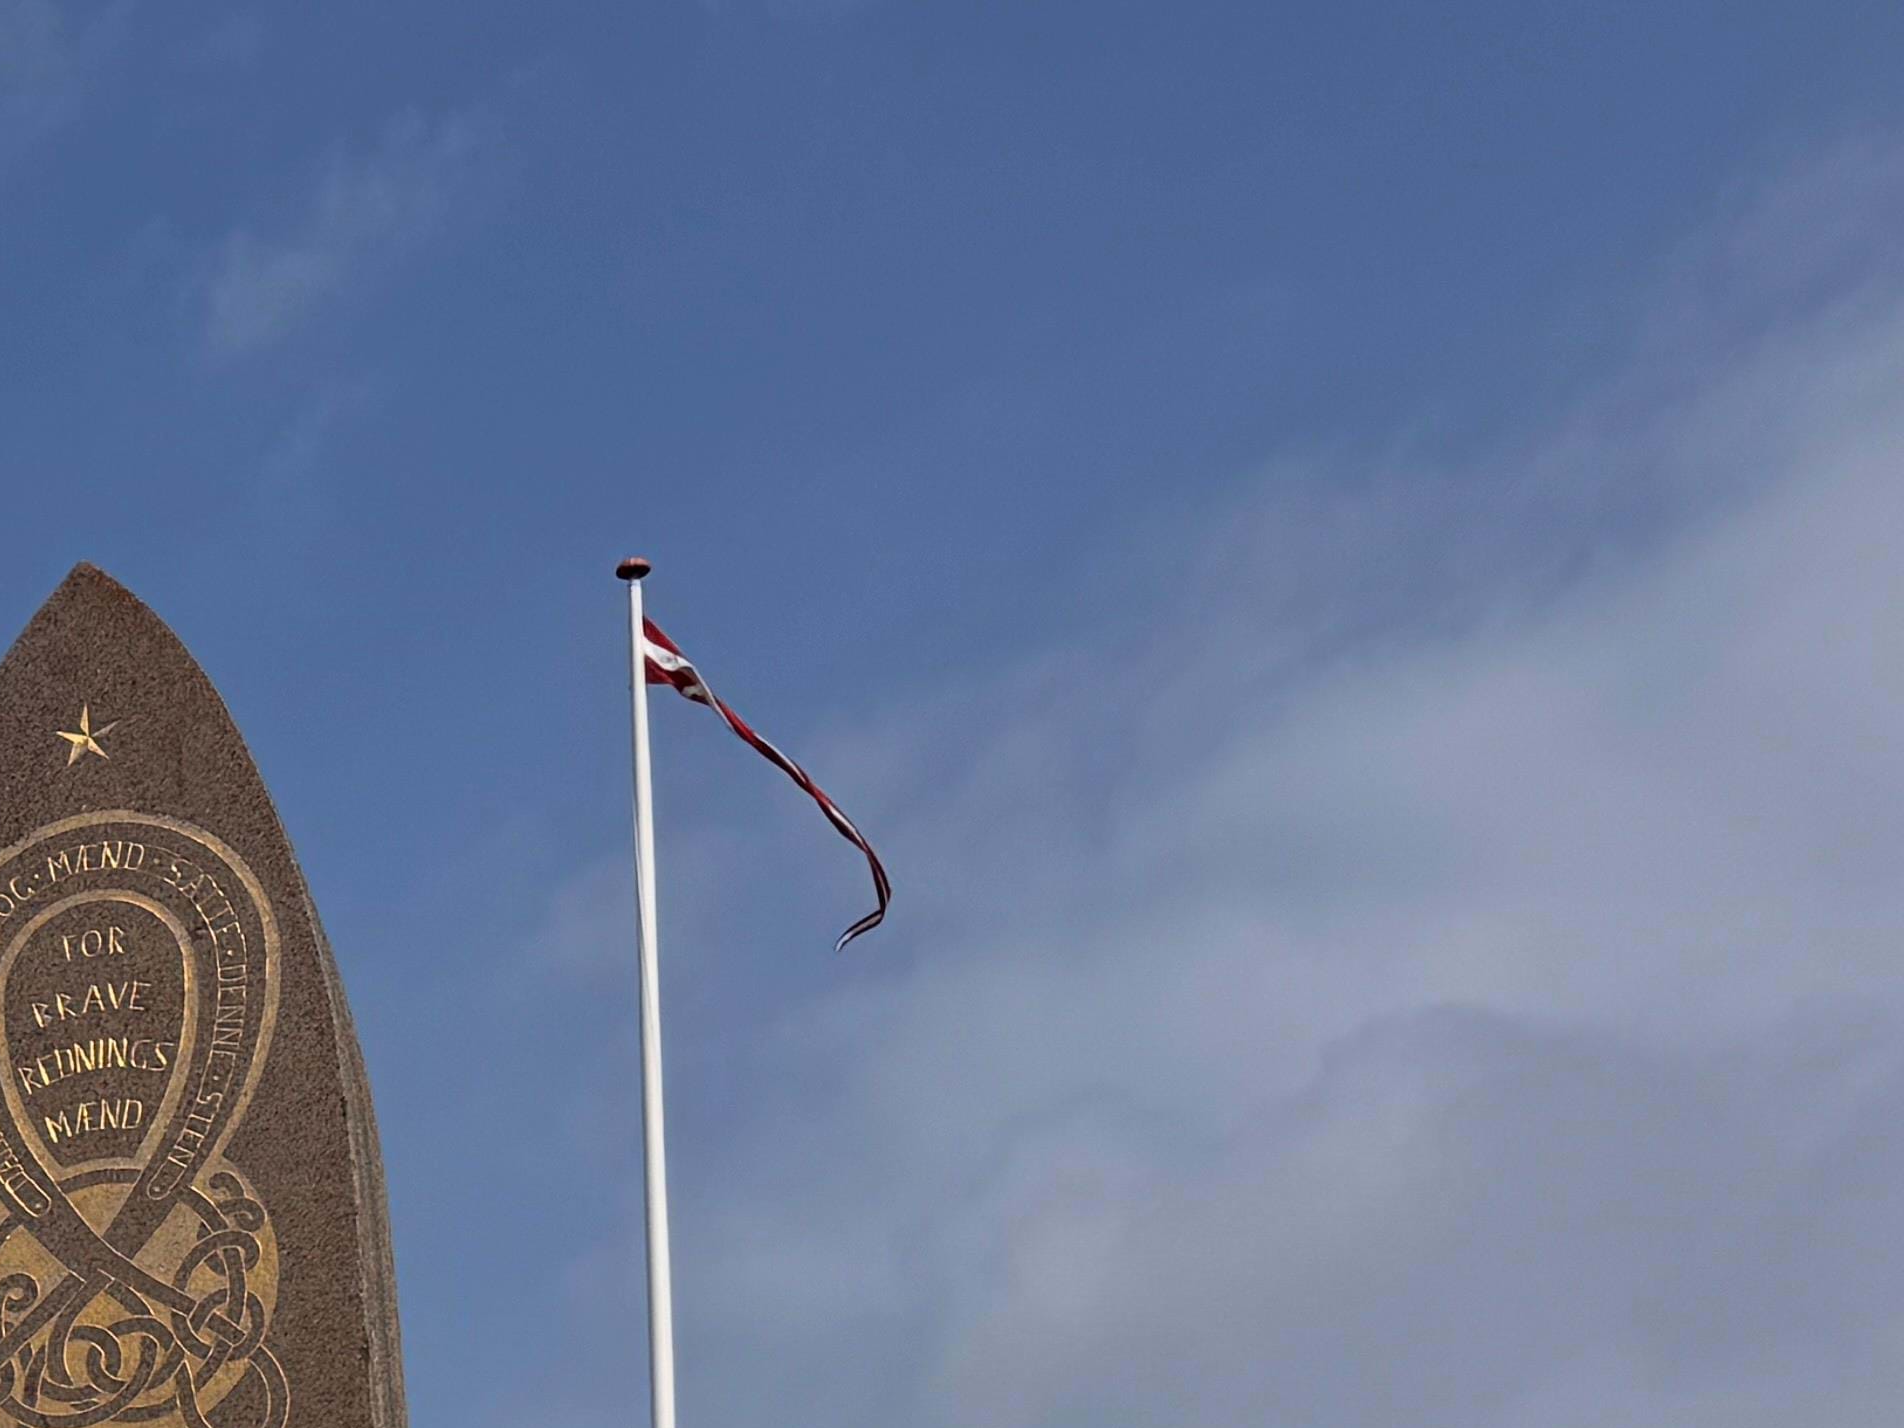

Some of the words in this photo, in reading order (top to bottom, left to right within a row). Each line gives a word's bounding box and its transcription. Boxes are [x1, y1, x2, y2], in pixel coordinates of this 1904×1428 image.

[47, 841, 145, 881] MÆND
[163, 857, 241, 936] SATTE
[63, 927, 125, 961] FOR
[32, 981, 152, 1028] BRAVE
[211, 964, 247, 1060] DENNE
[18, 1038, 175, 1095] REDNINGS
[45, 1099, 142, 1143] MÆND
[167, 1092, 223, 1167] STEN
